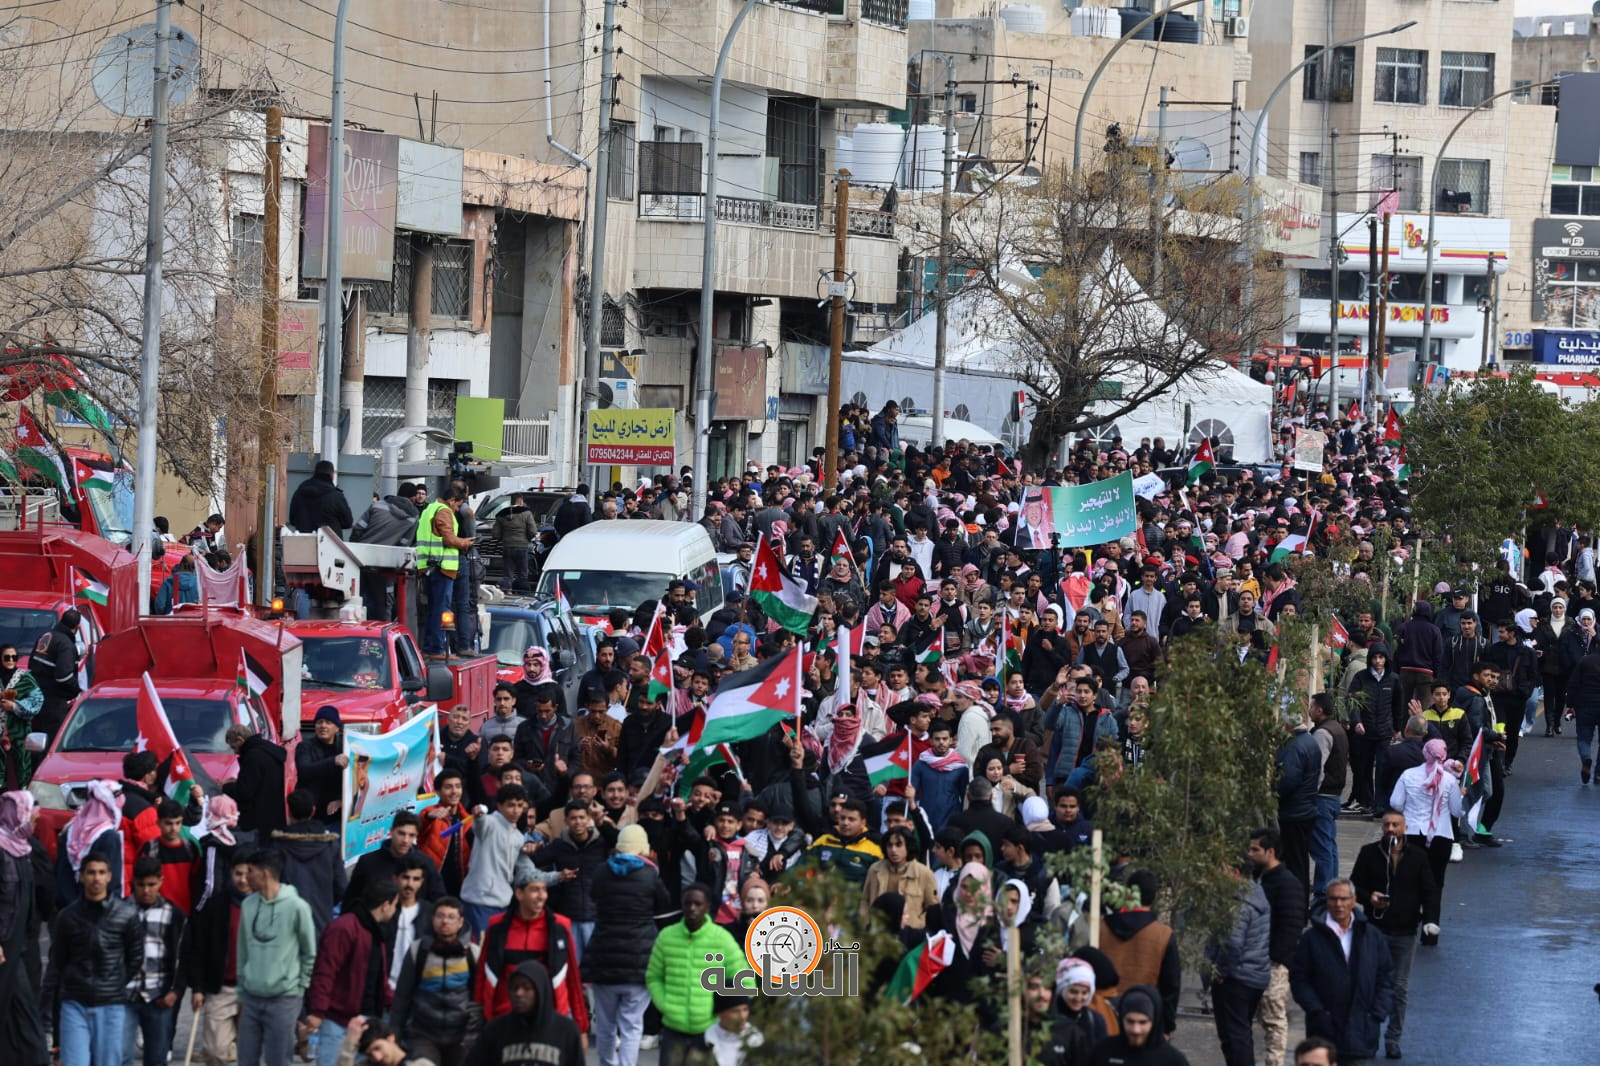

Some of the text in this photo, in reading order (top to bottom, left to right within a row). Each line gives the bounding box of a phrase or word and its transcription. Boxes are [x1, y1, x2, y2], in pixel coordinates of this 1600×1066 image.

[343, 224, 378, 256] ALOON
[1503, 332, 1533, 347] 309
[1559, 337, 1600, 354] يدلية
[592, 419, 615, 439] للبيع
[618, 419, 648, 439] تجاري
[590, 447, 634, 460] 0795042344
[1078, 490, 1113, 513] للتهجير
[1113, 486, 1120, 500] لا
[1062, 519, 1097, 537] البديل
[1099, 511, 1125, 533] للوطن
